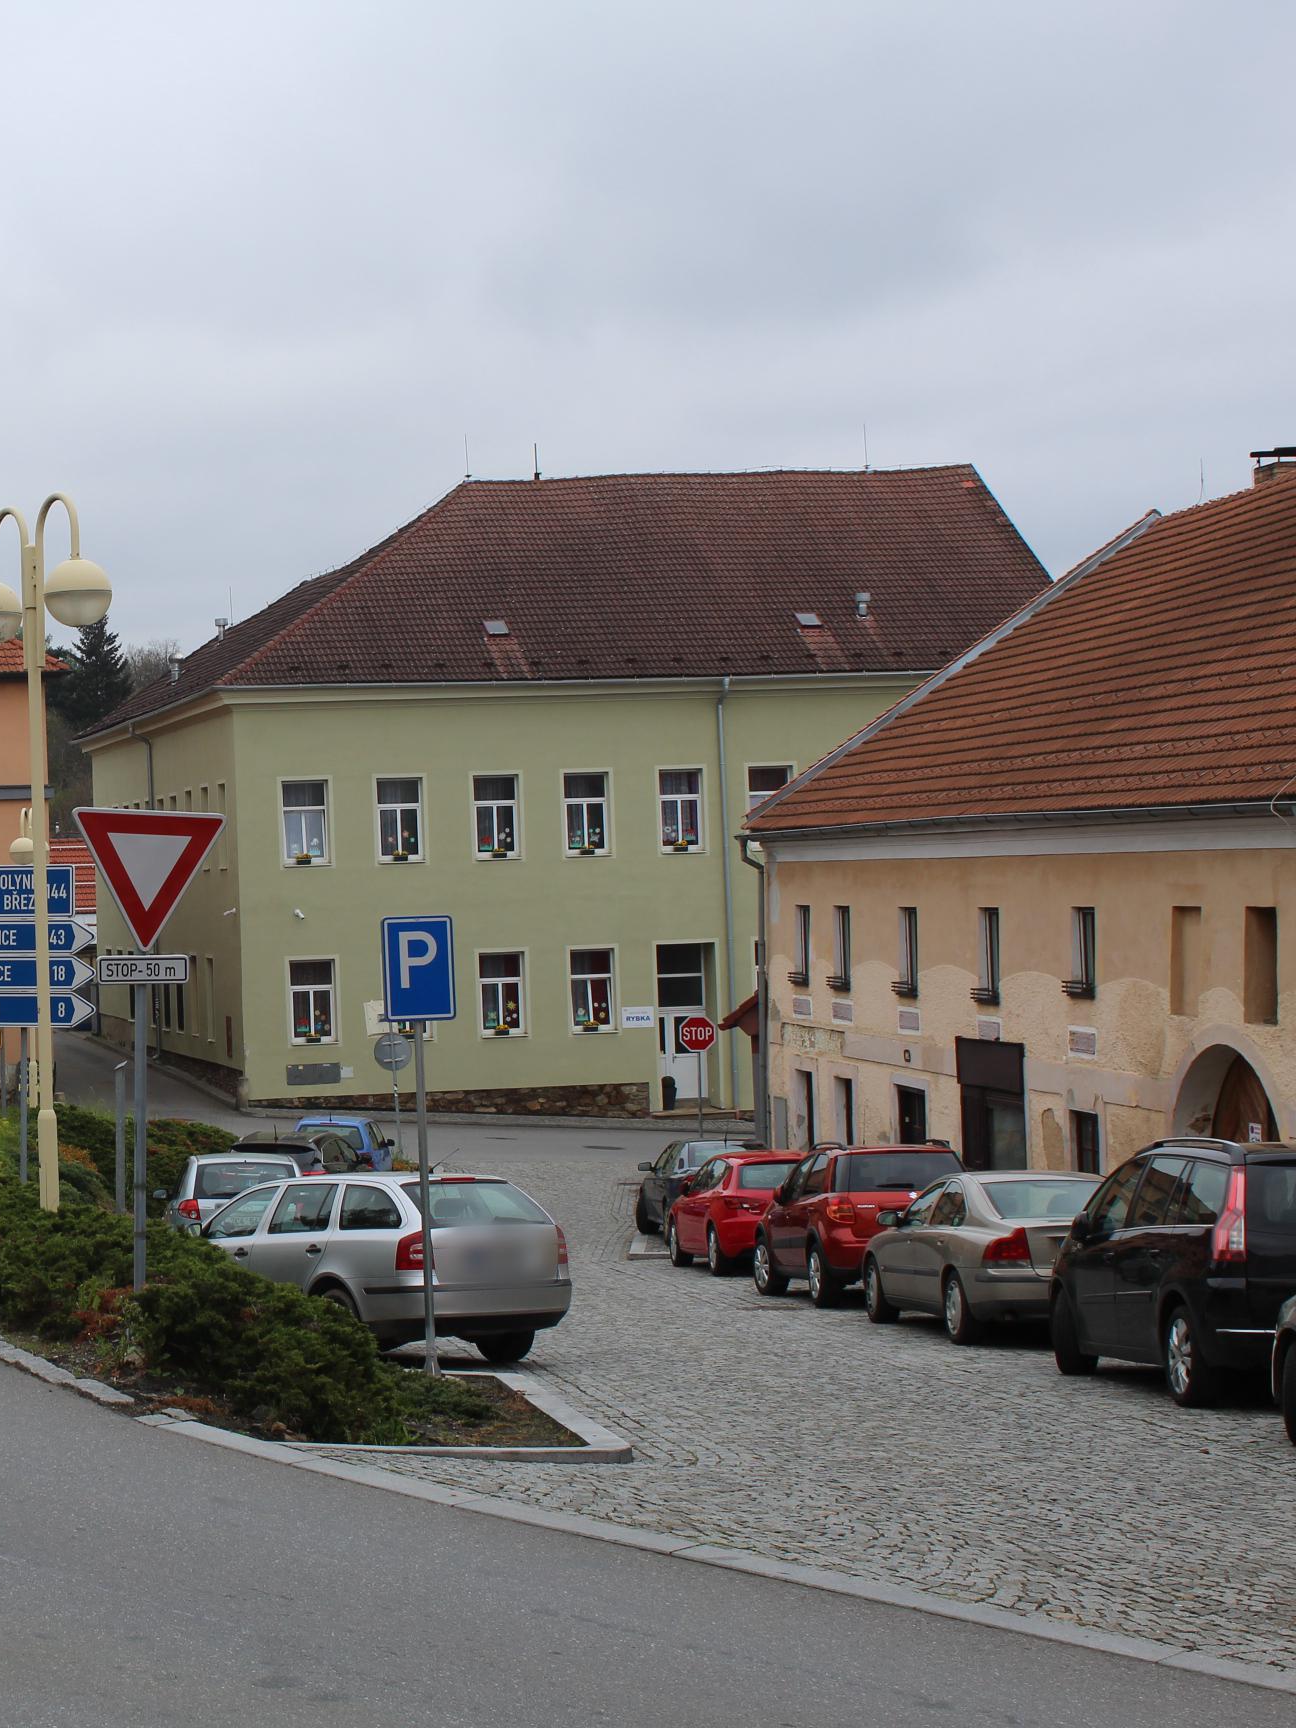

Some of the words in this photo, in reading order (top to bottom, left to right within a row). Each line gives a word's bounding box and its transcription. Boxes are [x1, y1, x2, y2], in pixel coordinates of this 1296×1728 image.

[47, 883, 67, 899] 144
[4, 890, 35, 910] BŘEZ
[49, 929, 65, 945] 43
[399, 930, 437, 989] P
[52, 965, 66, 981] 18
[146, 963, 160, 977] 50
[165, 966, 176, 977] m
[57, 1002, 65, 1017] 8
[683, 1027, 713, 1041] STOP
